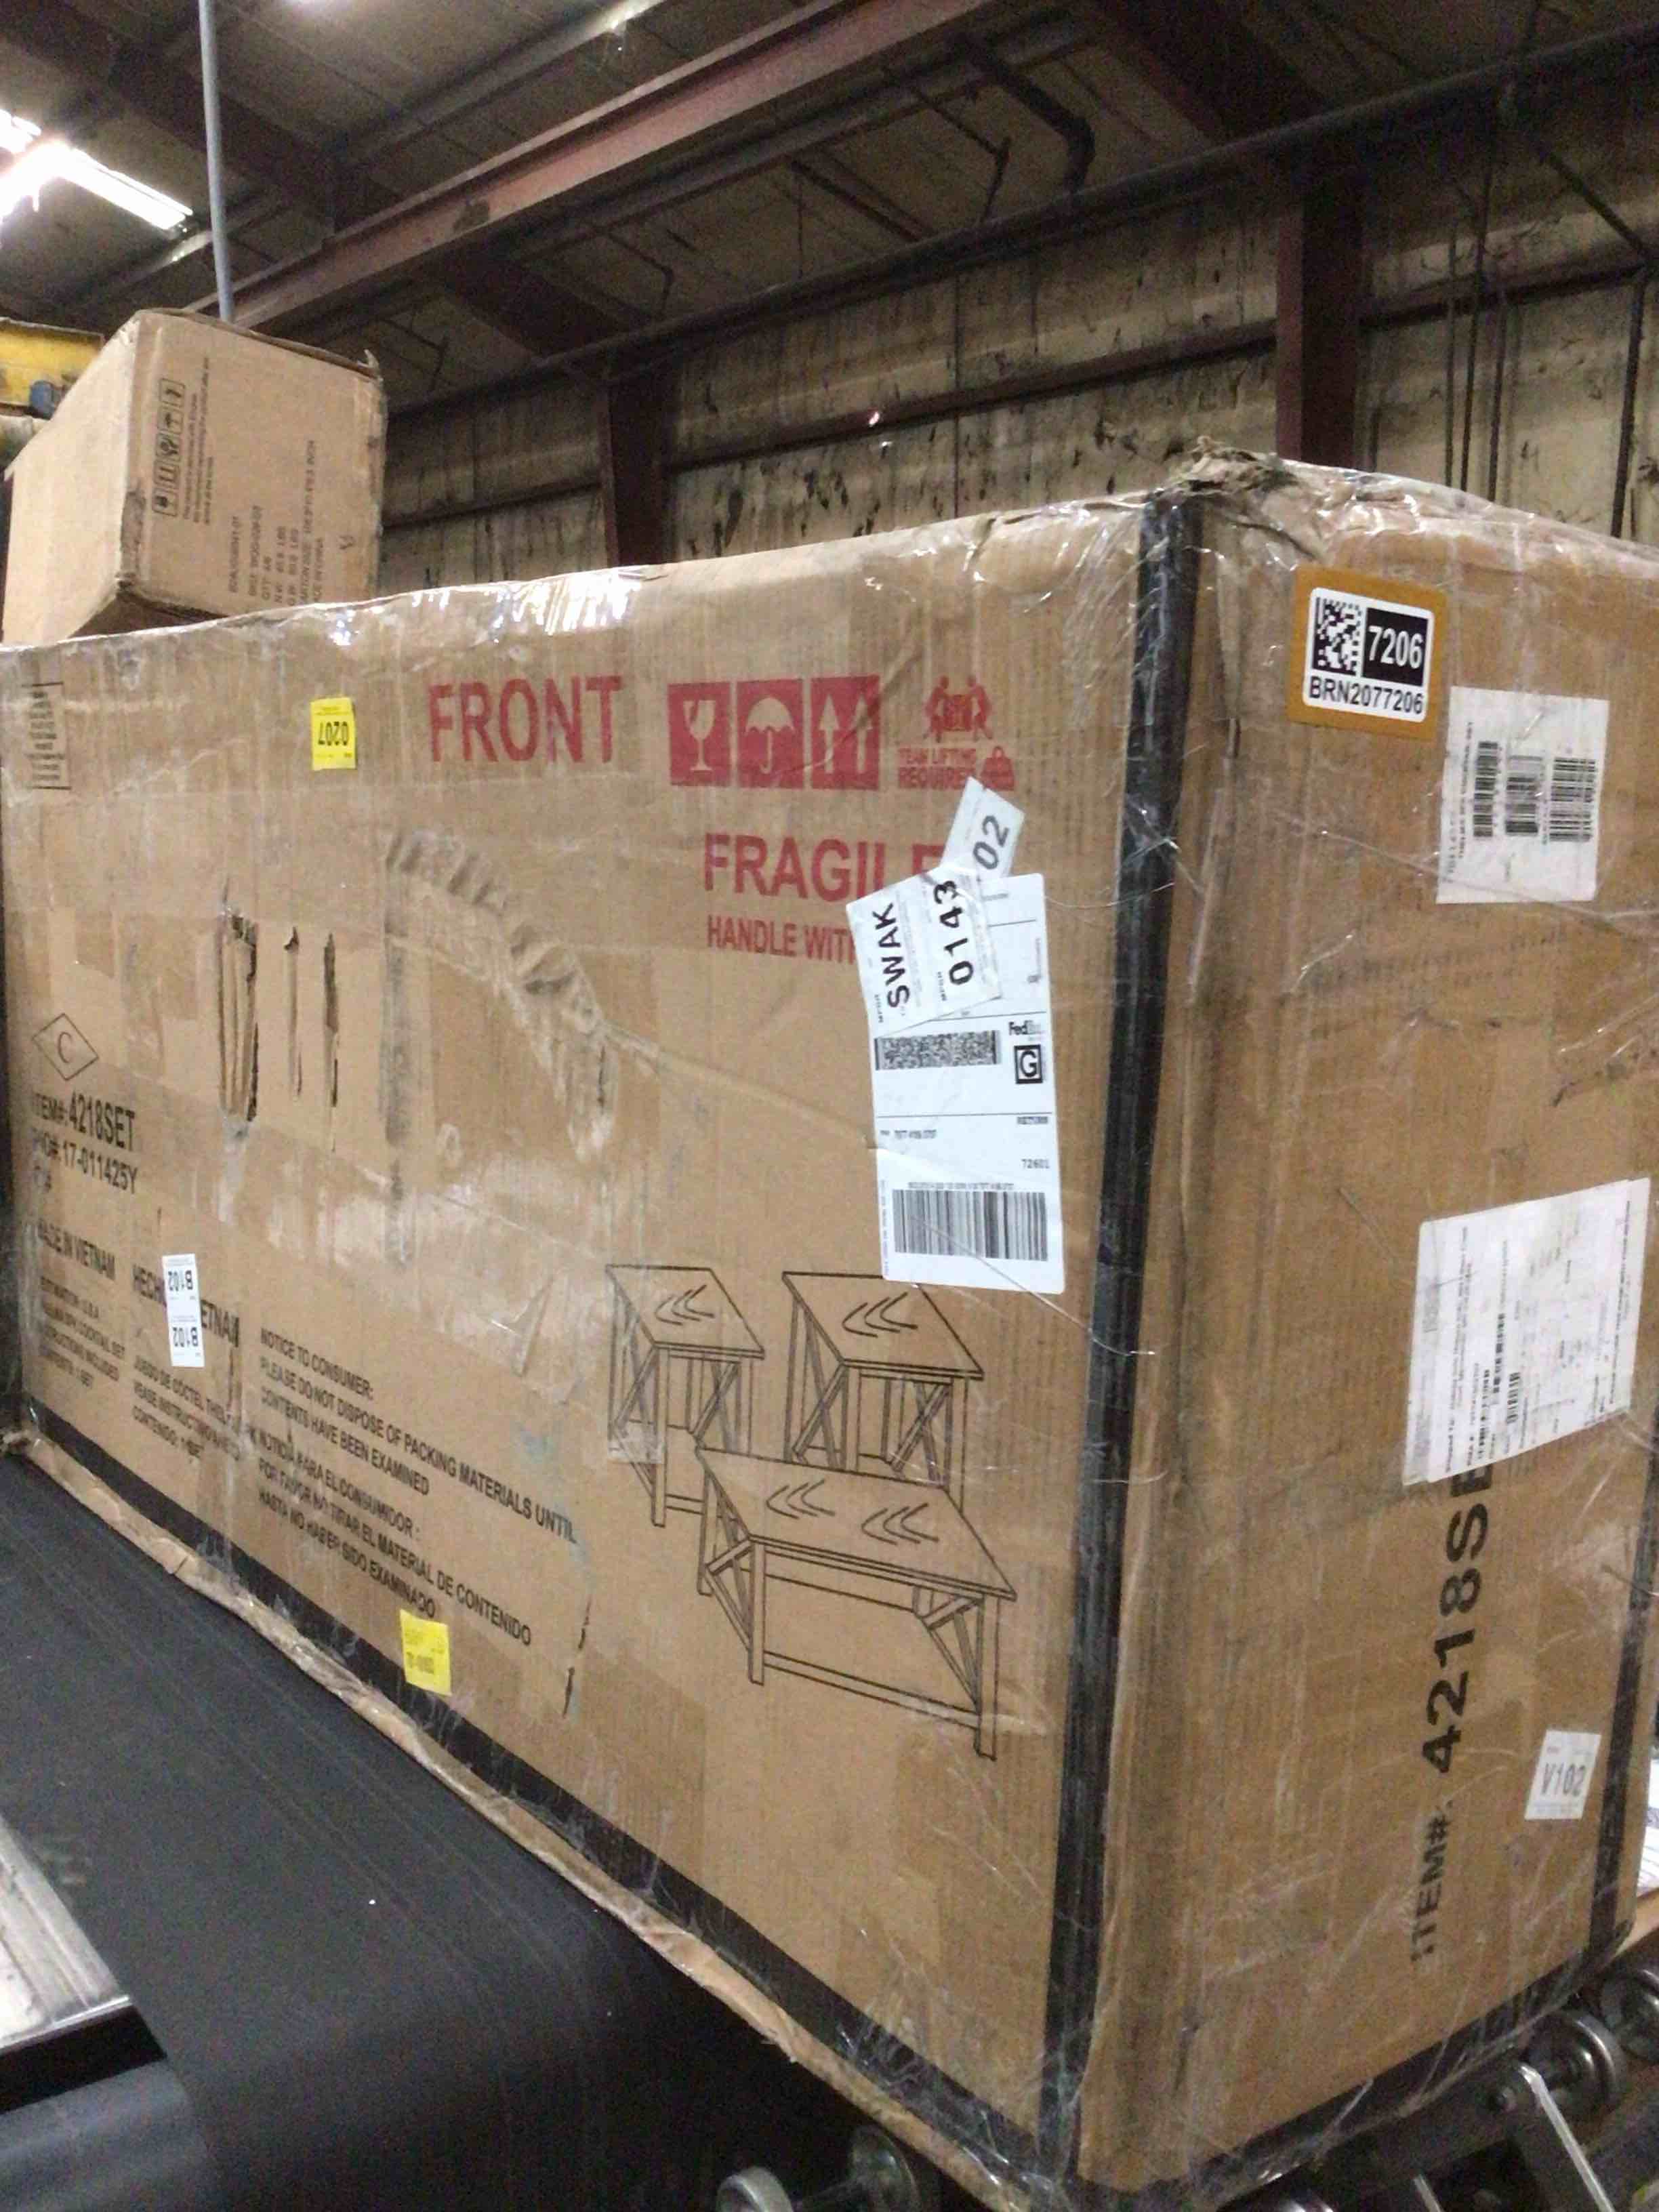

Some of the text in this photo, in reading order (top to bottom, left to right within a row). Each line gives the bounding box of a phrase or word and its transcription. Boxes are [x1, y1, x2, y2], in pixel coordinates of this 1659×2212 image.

[1367, 626, 1423, 670] 7206
[428, 674, 622, 764] FRONT
[1309, 676, 1424, 716] BRN2077206
[318, 721, 349, 747] 0207
[707, 914, 798, 958] HANDLE
[873, 902, 910, 1008] SWAK
[933, 880, 974, 985] 0143
[68, 1090, 136, 1152] 4218SET
[201, 1298, 239, 1349] ETNAM
[260, 1328, 373, 1401] NOTICE TO CONSUMER:
[260, 1355, 577, 1544] PLEASE DO NOT DISPOSE OF PACKING MATERIALS UNTIL
[261, 1385, 430, 1496] CONTENTS HAVE BEEN EXAMINED
[325, 1468, 339, 1492] EL
[341, 1541, 367, 1572] SIDO
[369, 1559, 436, 1619] EXAMINADO
[362, 1522, 376, 1548] EL
[377, 1533, 434, 1585] MATERIAL
[436, 1569, 454, 1597] DE
[455, 1582, 532, 1647] CONTENIDO
[1422, 1463, 1493, 1775] 4218SE
